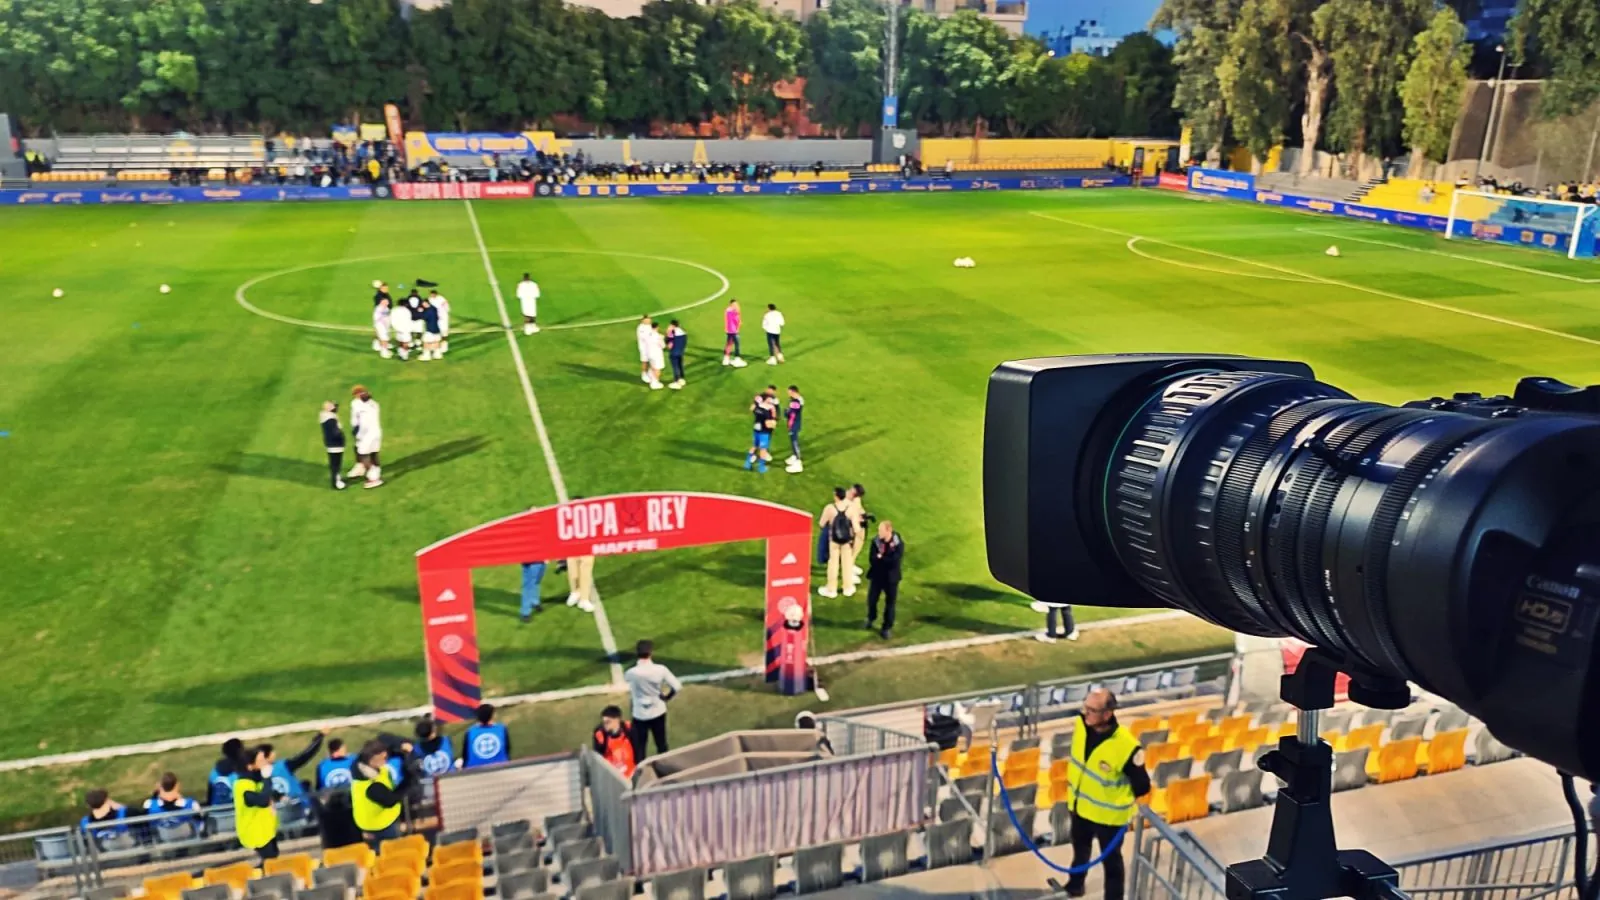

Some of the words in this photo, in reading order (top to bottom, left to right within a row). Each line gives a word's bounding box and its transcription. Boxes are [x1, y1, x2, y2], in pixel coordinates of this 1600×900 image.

[557, 501, 618, 541] COPA
[647, 496, 688, 532] REY
[592, 538, 659, 555] MAPFRE
[1526, 574, 1581, 599] Canon
